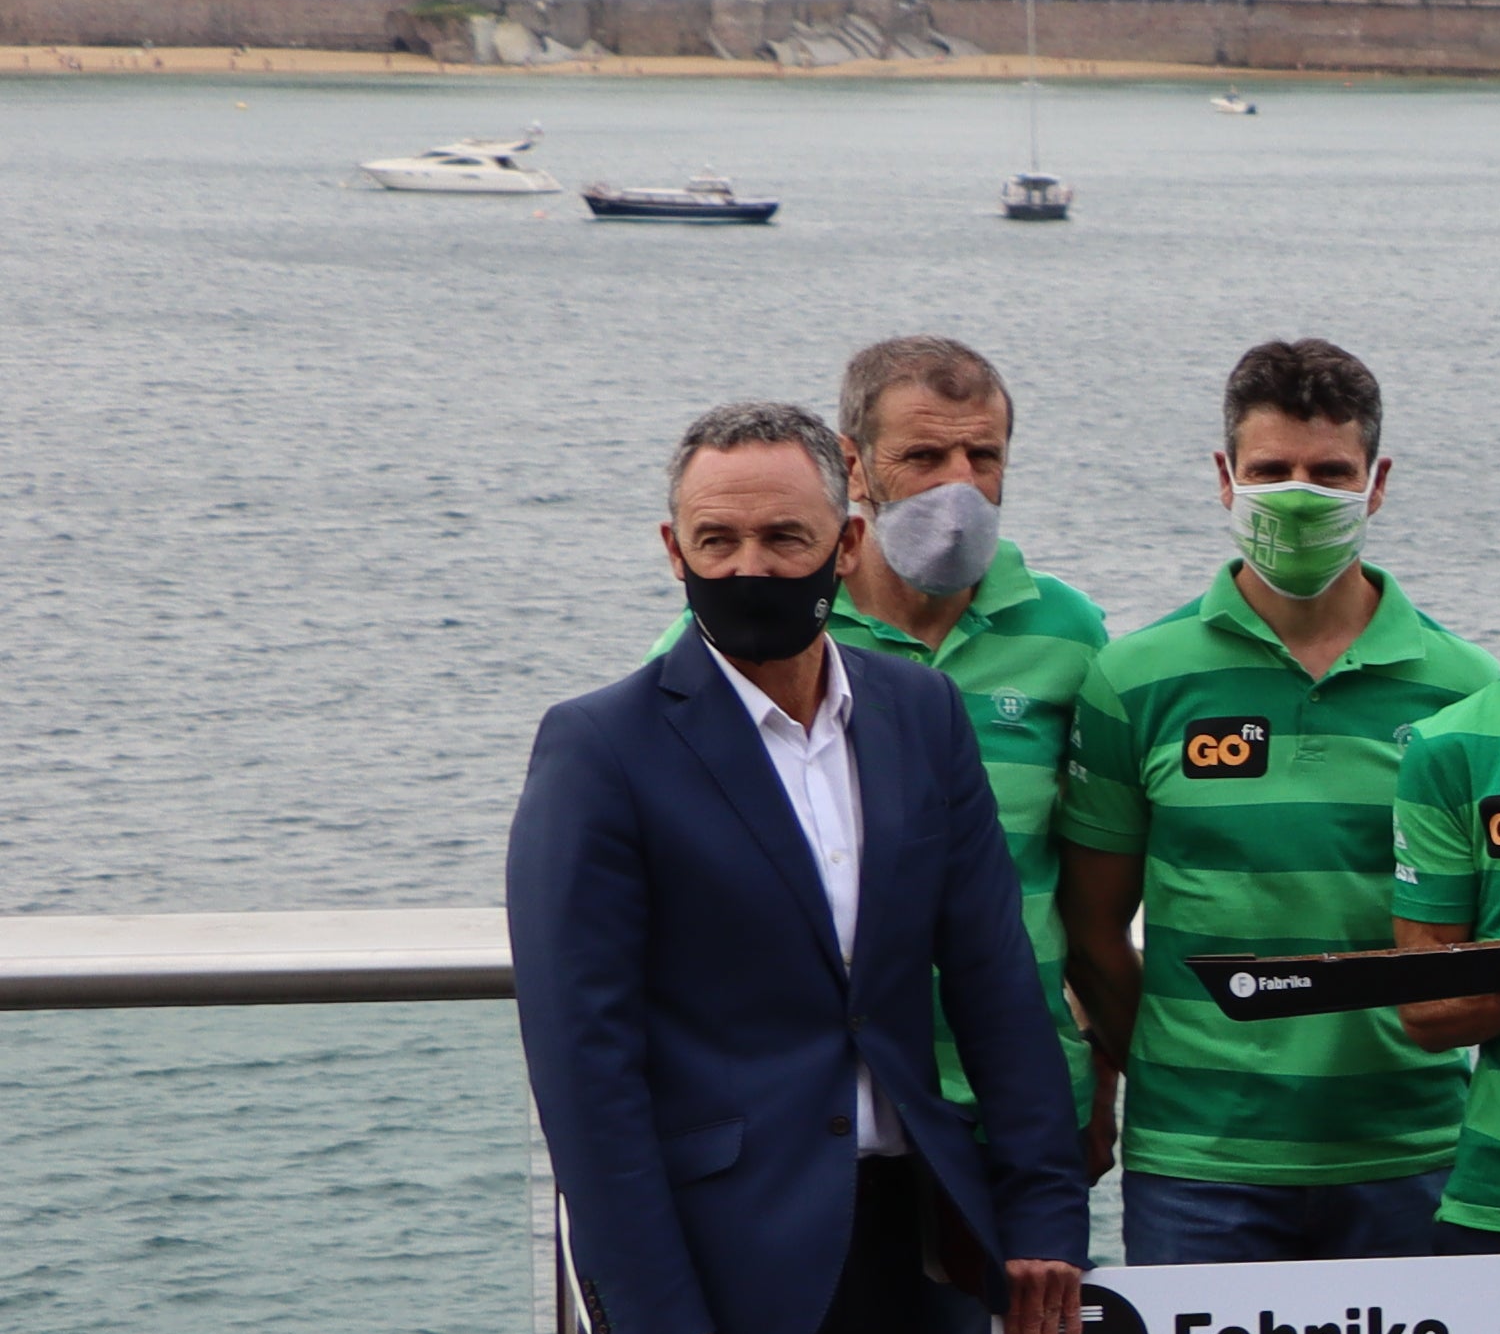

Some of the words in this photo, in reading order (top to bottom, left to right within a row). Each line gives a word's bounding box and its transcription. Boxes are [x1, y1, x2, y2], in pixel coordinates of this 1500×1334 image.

[1188, 734, 1250, 767] GO
[1240, 723, 1265, 742] fit
[1258, 974, 1313, 991] Fabrika
